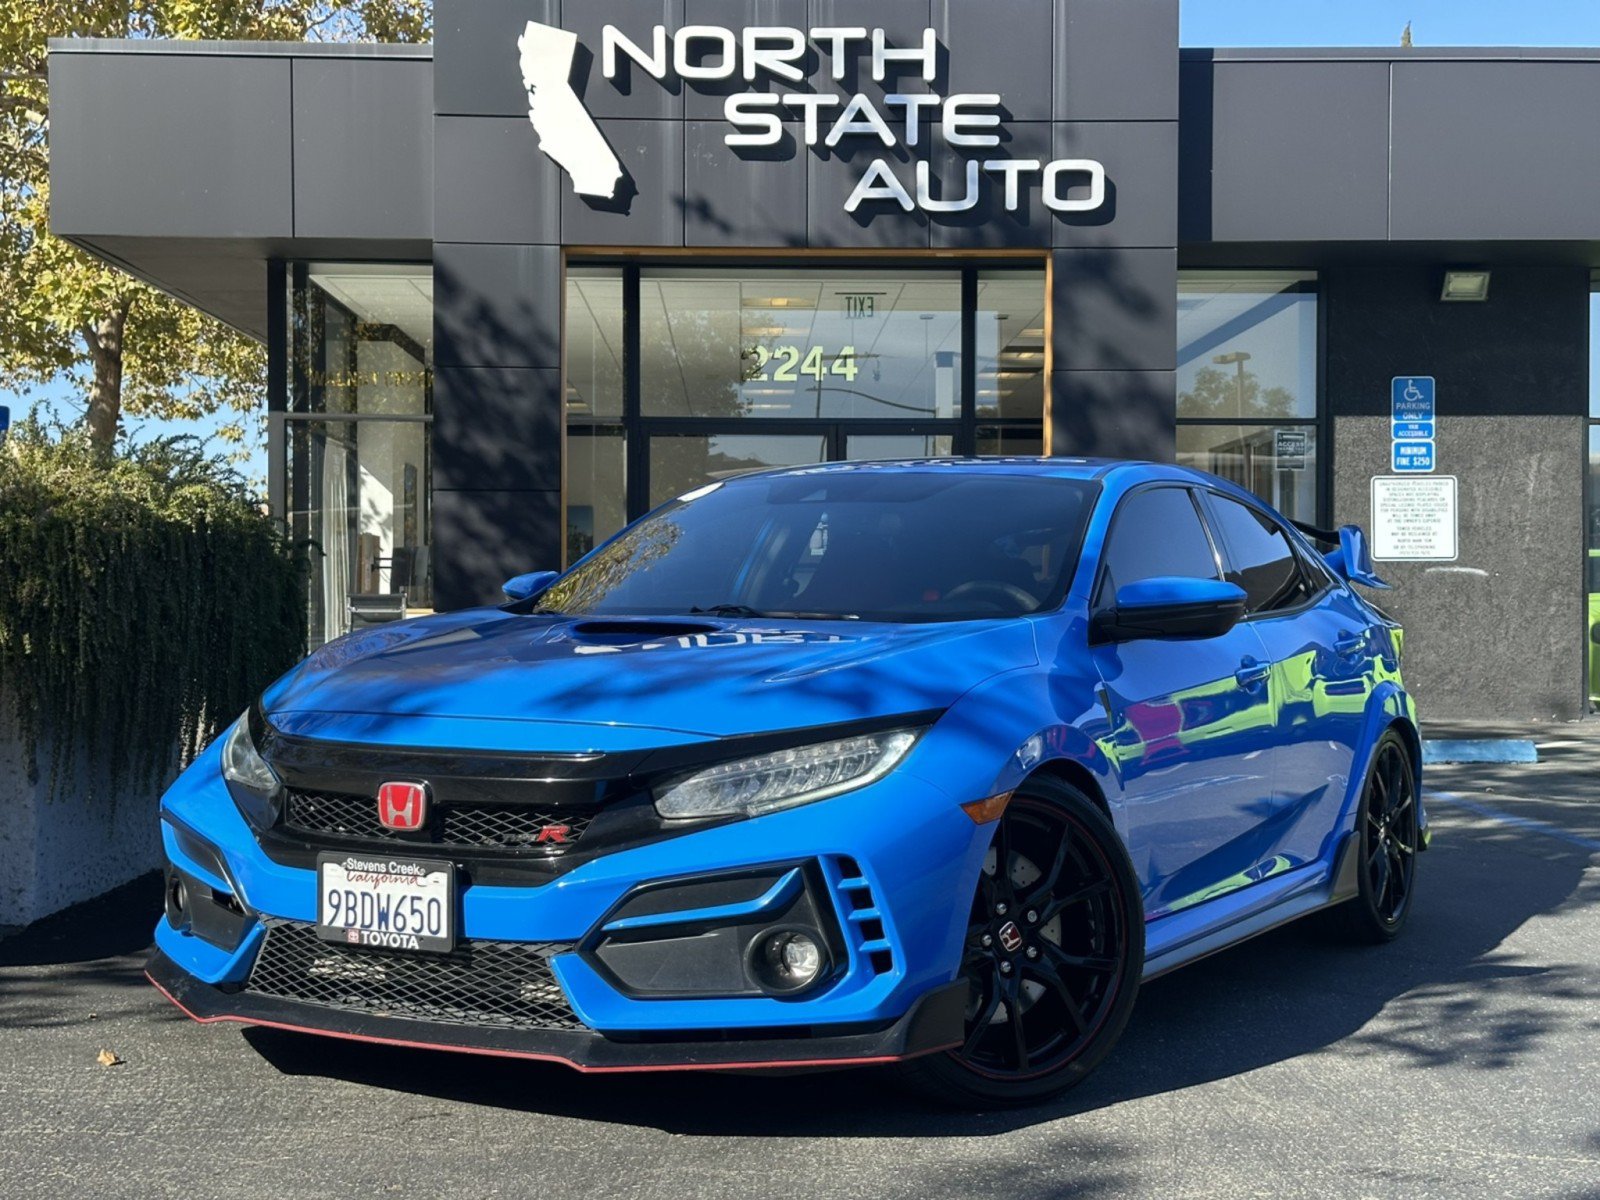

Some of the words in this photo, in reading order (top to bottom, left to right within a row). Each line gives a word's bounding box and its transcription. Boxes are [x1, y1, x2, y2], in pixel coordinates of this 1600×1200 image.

[602, 25, 936, 81] NORTH
[724, 93, 1001, 147] STATE
[844, 159, 1106, 212] AUTO
[741, 345, 858, 382] 2244
[1396, 402, 1431, 410] PARKING
[1402, 412, 1424, 420] ONLY
[1396, 456, 1410, 466] FINE
[1413, 456, 1431, 466] $250
[536, 824, 571, 843] R
[346, 857, 387, 873] Stevens
[388, 861, 421, 875] Creek
[328, 888, 441, 936] 9BDW650
[361, 931, 420, 950] TOYOTA
